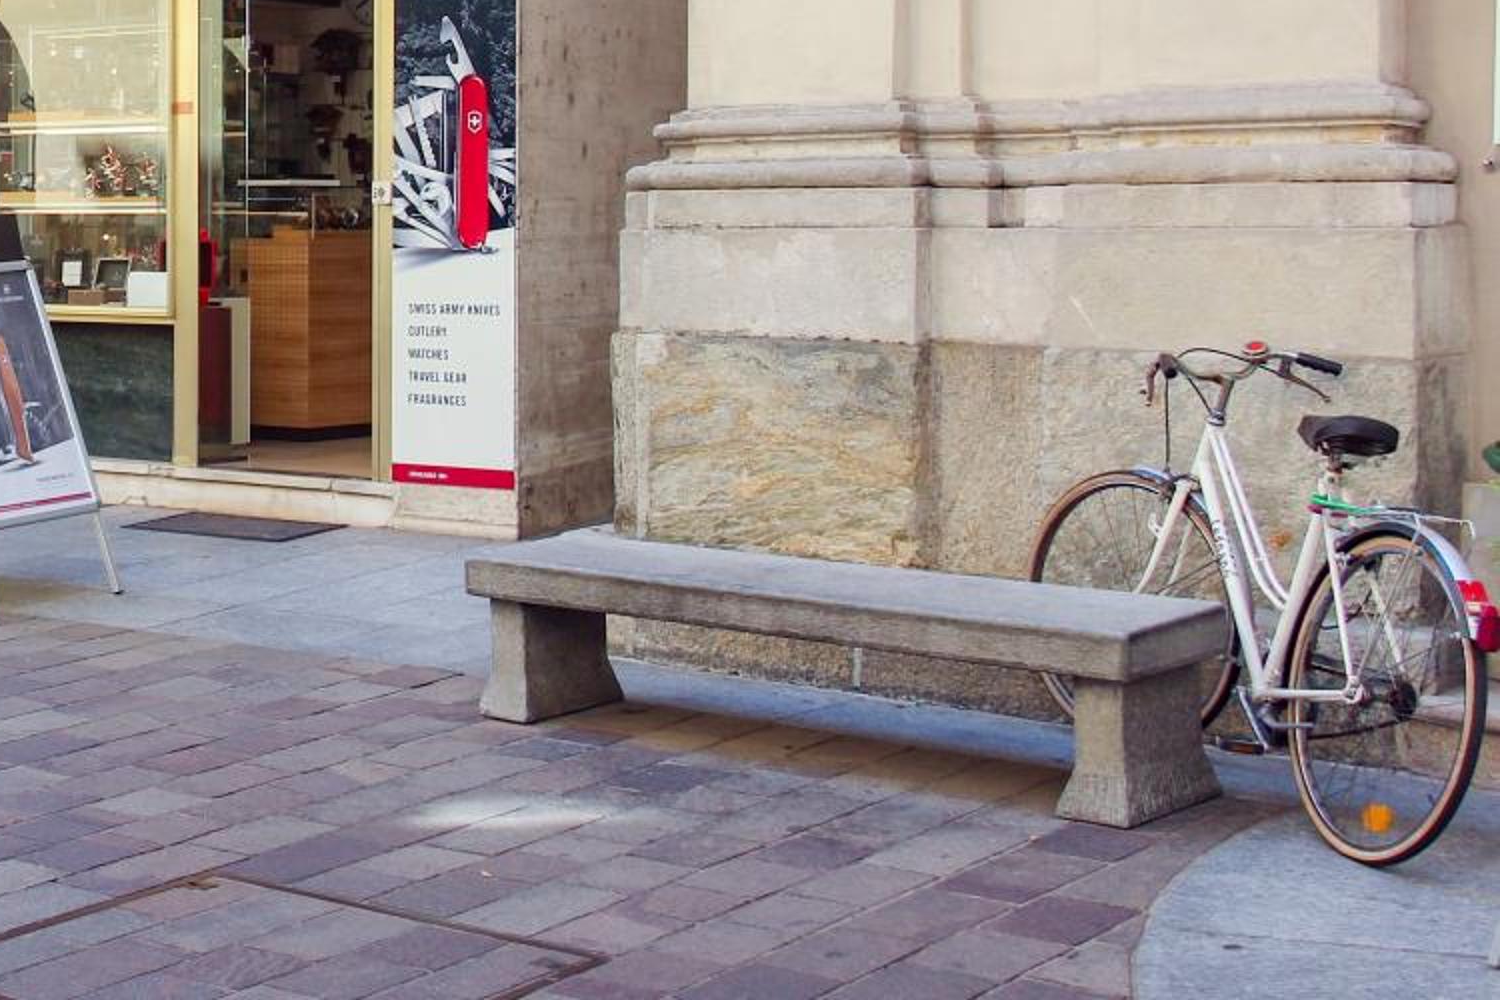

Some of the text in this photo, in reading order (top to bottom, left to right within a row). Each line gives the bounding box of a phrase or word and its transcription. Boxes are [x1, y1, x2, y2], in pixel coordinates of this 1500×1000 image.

[408, 303, 501, 316] SWISS ARMY KNIVES
[407, 325, 447, 337] CUTLERY
[408, 348, 449, 360] WATCHES
[408, 371, 467, 383] TRAVEL GEAR
[407, 393, 467, 407] FRAGRANCES
